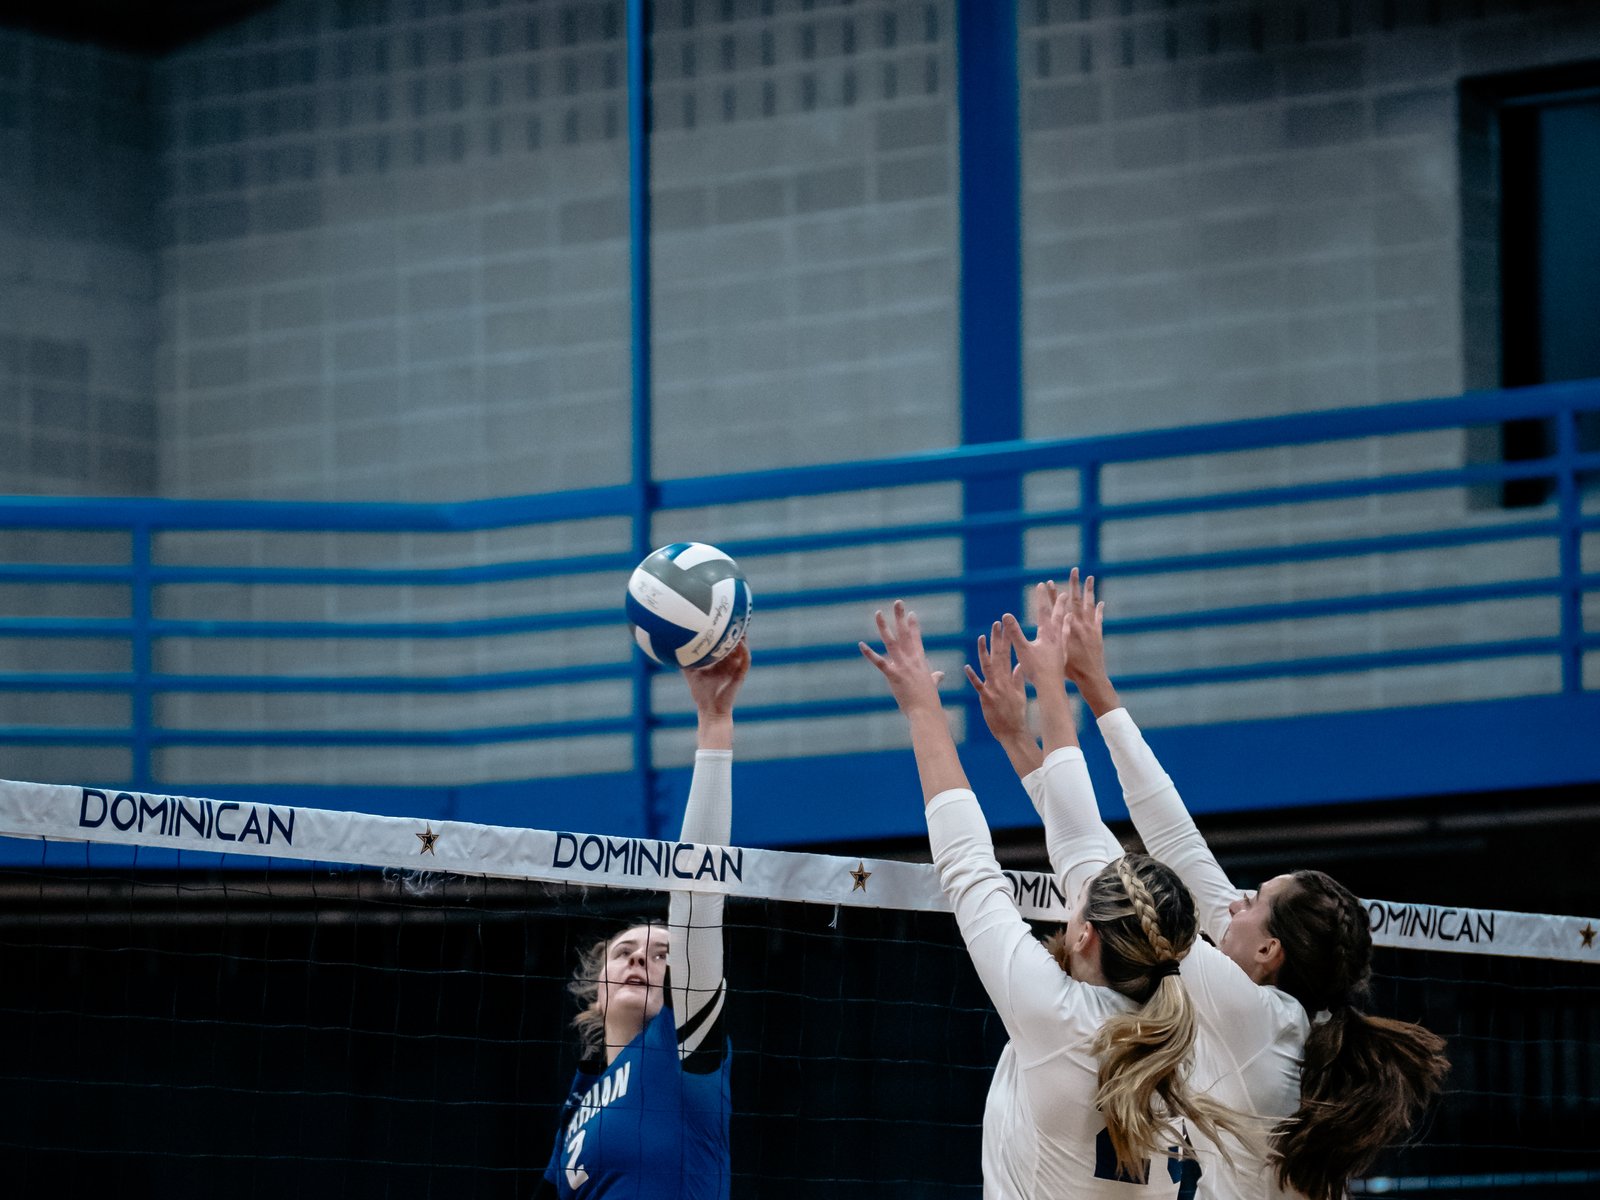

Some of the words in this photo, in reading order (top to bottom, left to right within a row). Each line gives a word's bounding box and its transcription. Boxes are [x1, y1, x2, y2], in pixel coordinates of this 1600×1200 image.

[79, 788, 295, 846] DOMINICAN
[553, 832, 743, 883] DOMINICAN
[1367, 902, 1495, 943] OMINICAN
[565, 1129, 589, 1190] 2
